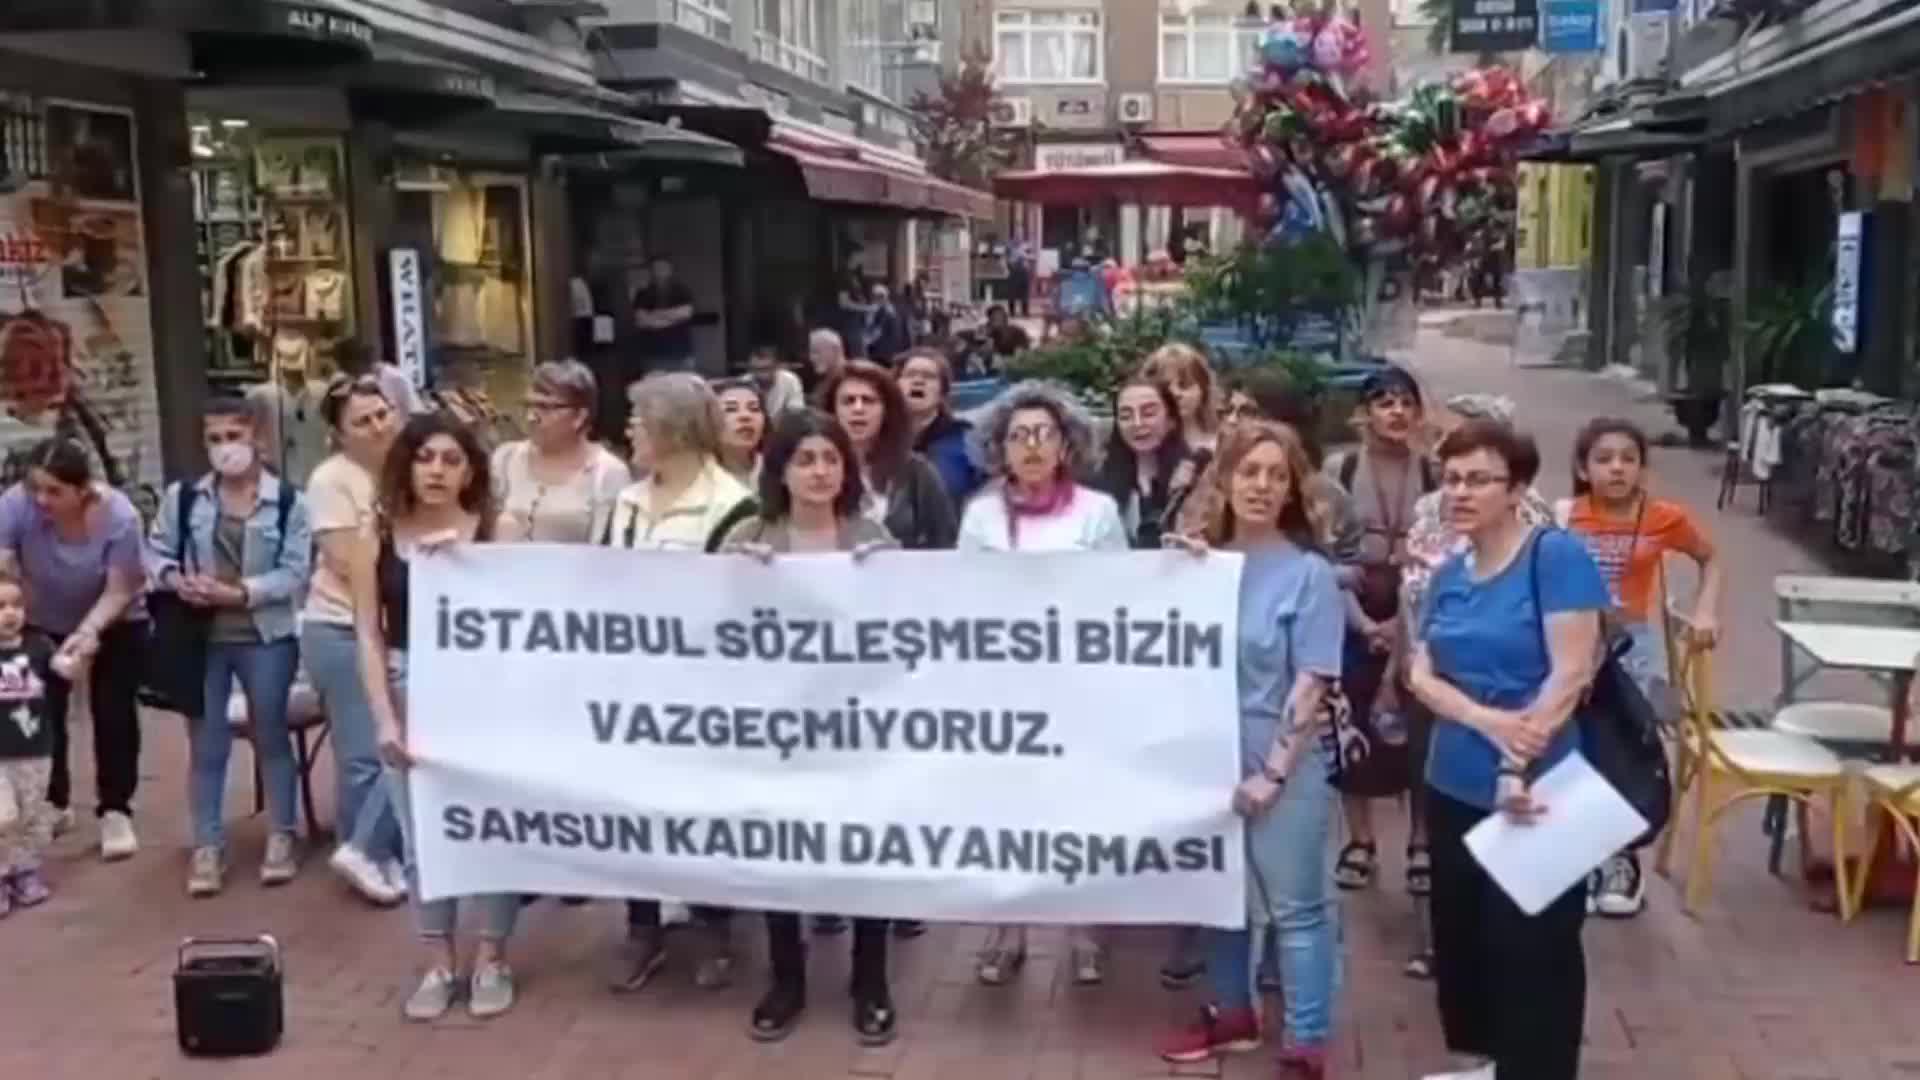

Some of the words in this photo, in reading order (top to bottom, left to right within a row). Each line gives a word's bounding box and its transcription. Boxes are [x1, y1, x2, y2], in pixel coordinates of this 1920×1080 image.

[437, 597, 706, 657] İSTANBUL
[714, 606, 1060, 671] SÖZLEŞMESİ
[1075, 606, 1222, 668] BİZİM
[588, 697, 1065, 761] VAZGEÇMİYORUZ.
[443, 805, 652, 853] SAMSUN
[663, 816, 827, 863] KADIN
[841, 824, 1225, 885] DAYANIŞMASI
